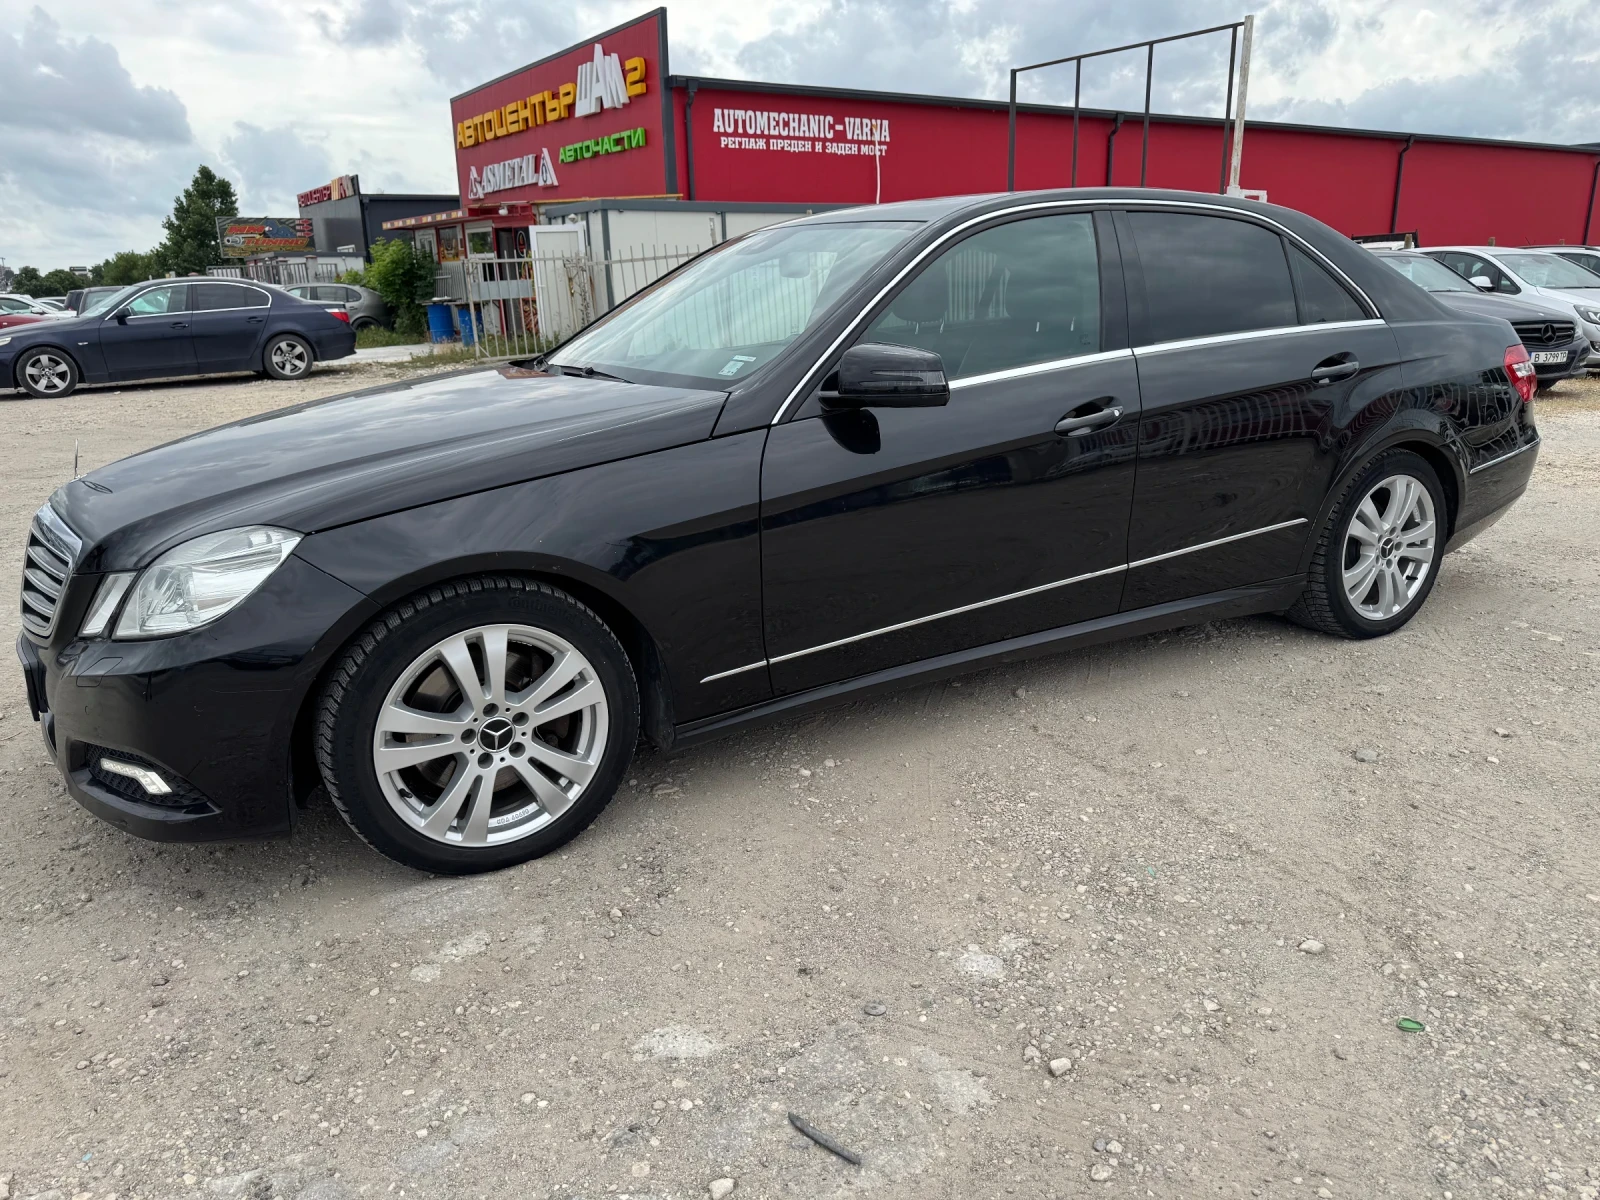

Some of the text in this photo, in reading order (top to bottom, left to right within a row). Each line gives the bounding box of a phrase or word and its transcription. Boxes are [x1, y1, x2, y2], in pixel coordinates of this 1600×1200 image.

[457, 43, 647, 149] АВТОЦЕНТЪР ШАМ 2
[713, 108, 890, 142] AUTOMECHANIC-VARNA
[558, 127, 647, 164] АВТОЧАСТИ
[720, 136, 887, 156] РЕГЛАЖ ПРЕДЕН И ЗАДЕН МОСТ
[481, 153, 539, 195] ASMETAL
[244, 237, 307, 246] TUNING
[1534, 353, 1540, 362] B
[1542, 353, 1560, 362] 3799
